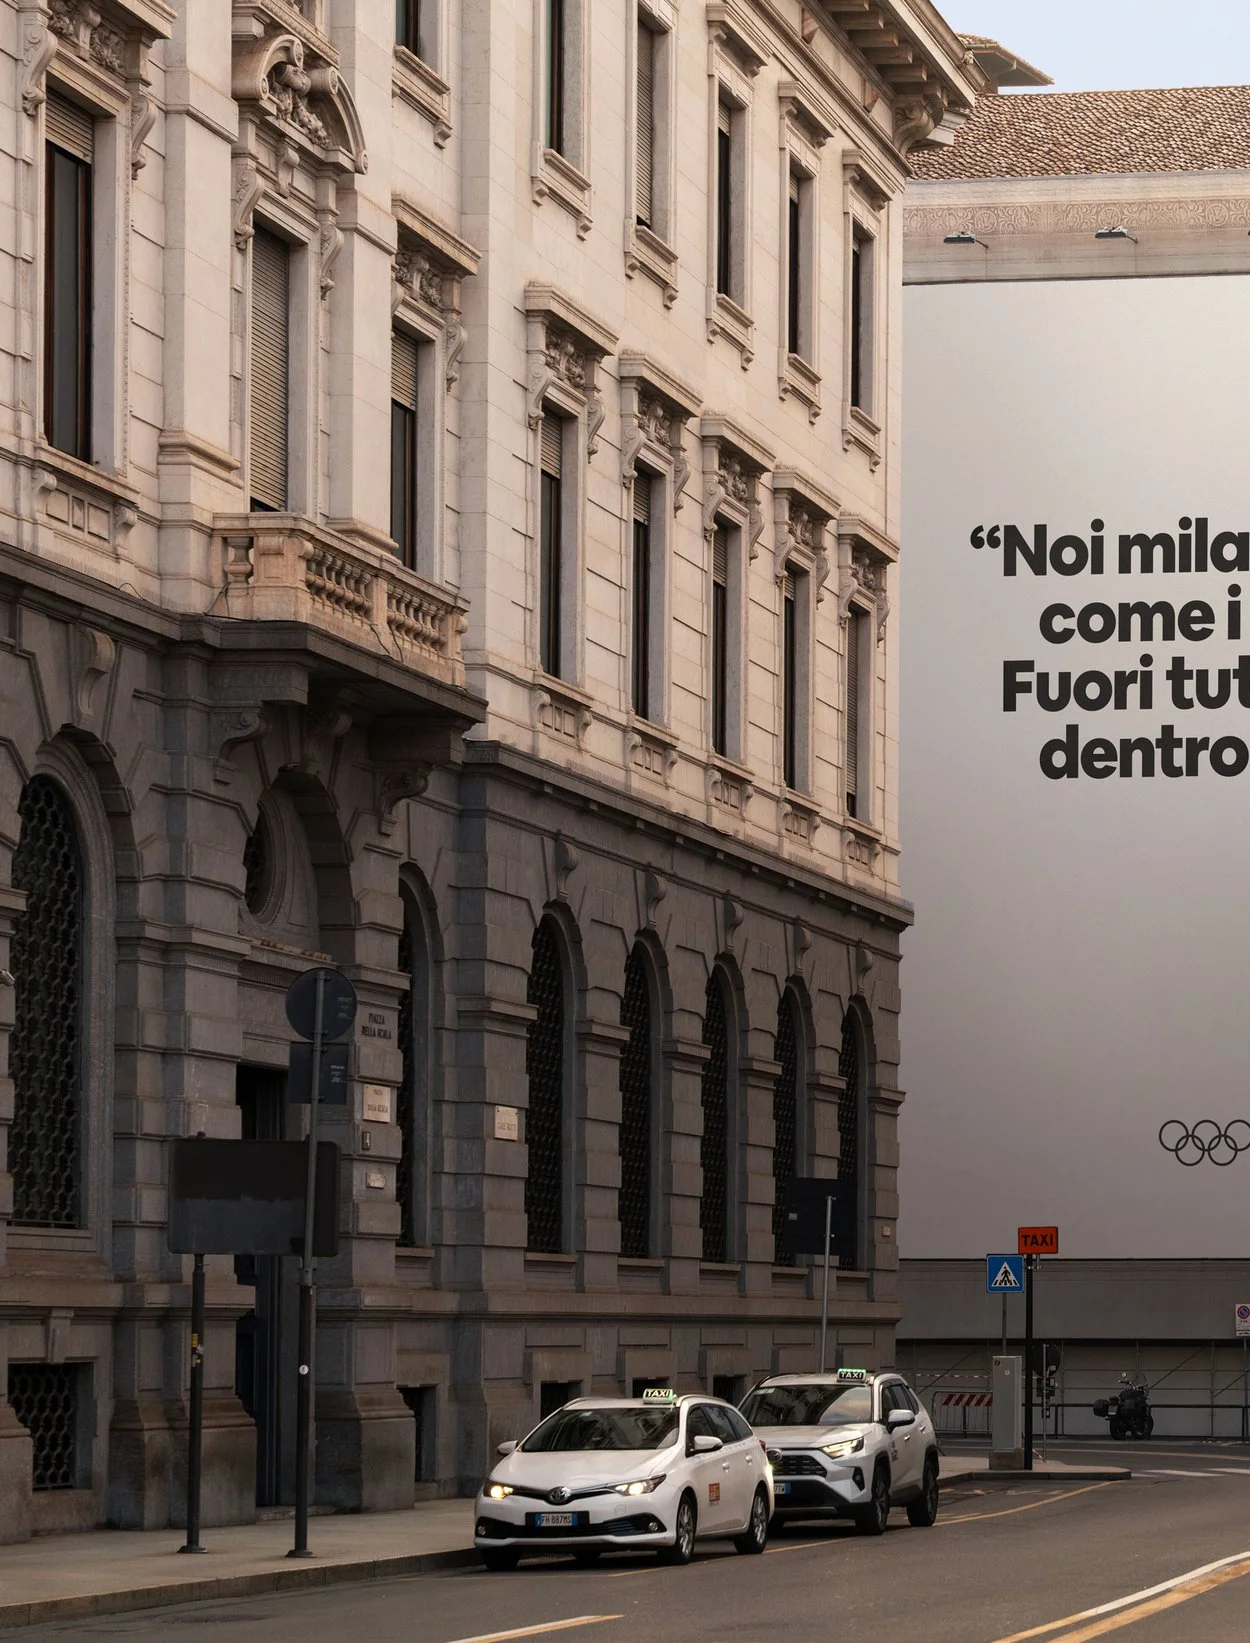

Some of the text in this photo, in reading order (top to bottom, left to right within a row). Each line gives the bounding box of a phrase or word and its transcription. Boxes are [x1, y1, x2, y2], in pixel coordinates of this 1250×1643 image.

[1038, 597, 1216, 645] come
[1226, 583, 1242, 640] i
[1002, 652, 1154, 713] Fuori
[1038, 723, 1250, 781] dentro
[1021, 1233, 1054, 1247] TAXI
[646, 1388, 671, 1398] TAXI
[840, 1371, 863, 1379] TAXI
